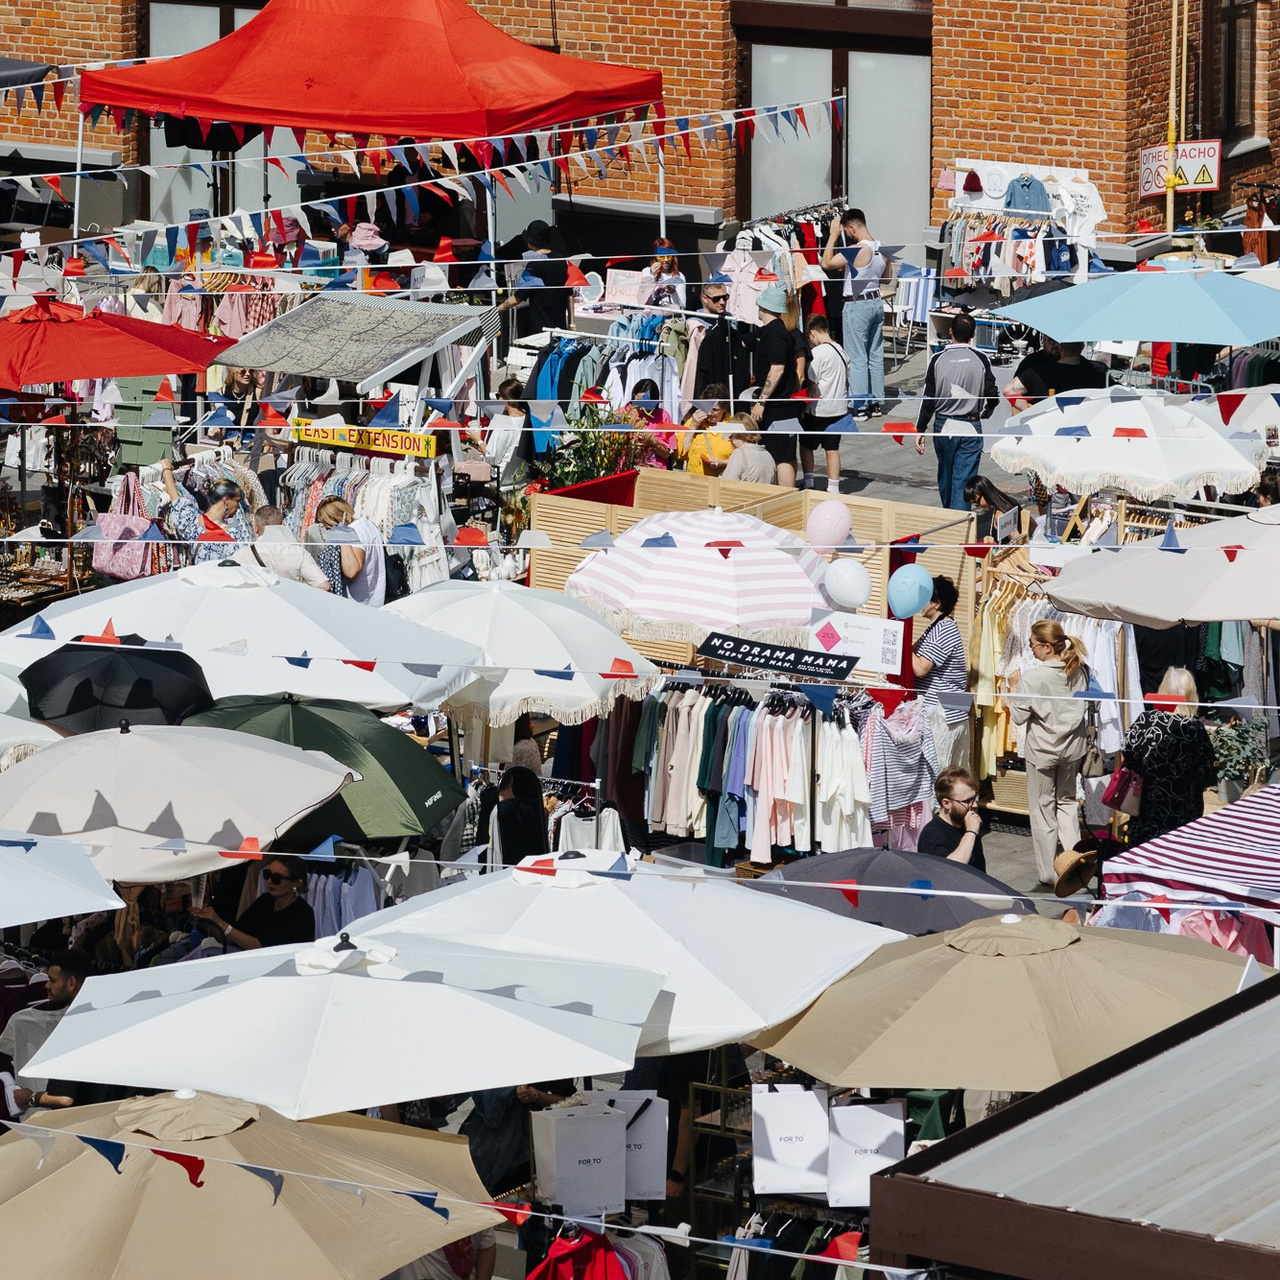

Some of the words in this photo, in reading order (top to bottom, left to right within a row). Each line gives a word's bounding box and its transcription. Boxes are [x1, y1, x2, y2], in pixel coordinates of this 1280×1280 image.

[348, 428, 421, 452] EXTENSION
[711, 637, 734, 649] NO
[740, 644, 795, 661] DRAMA
[801, 655, 848, 669] MAMA
[717, 649, 743, 659] МЕРЧ
[745, 655, 766, 664] ДЛЯ
